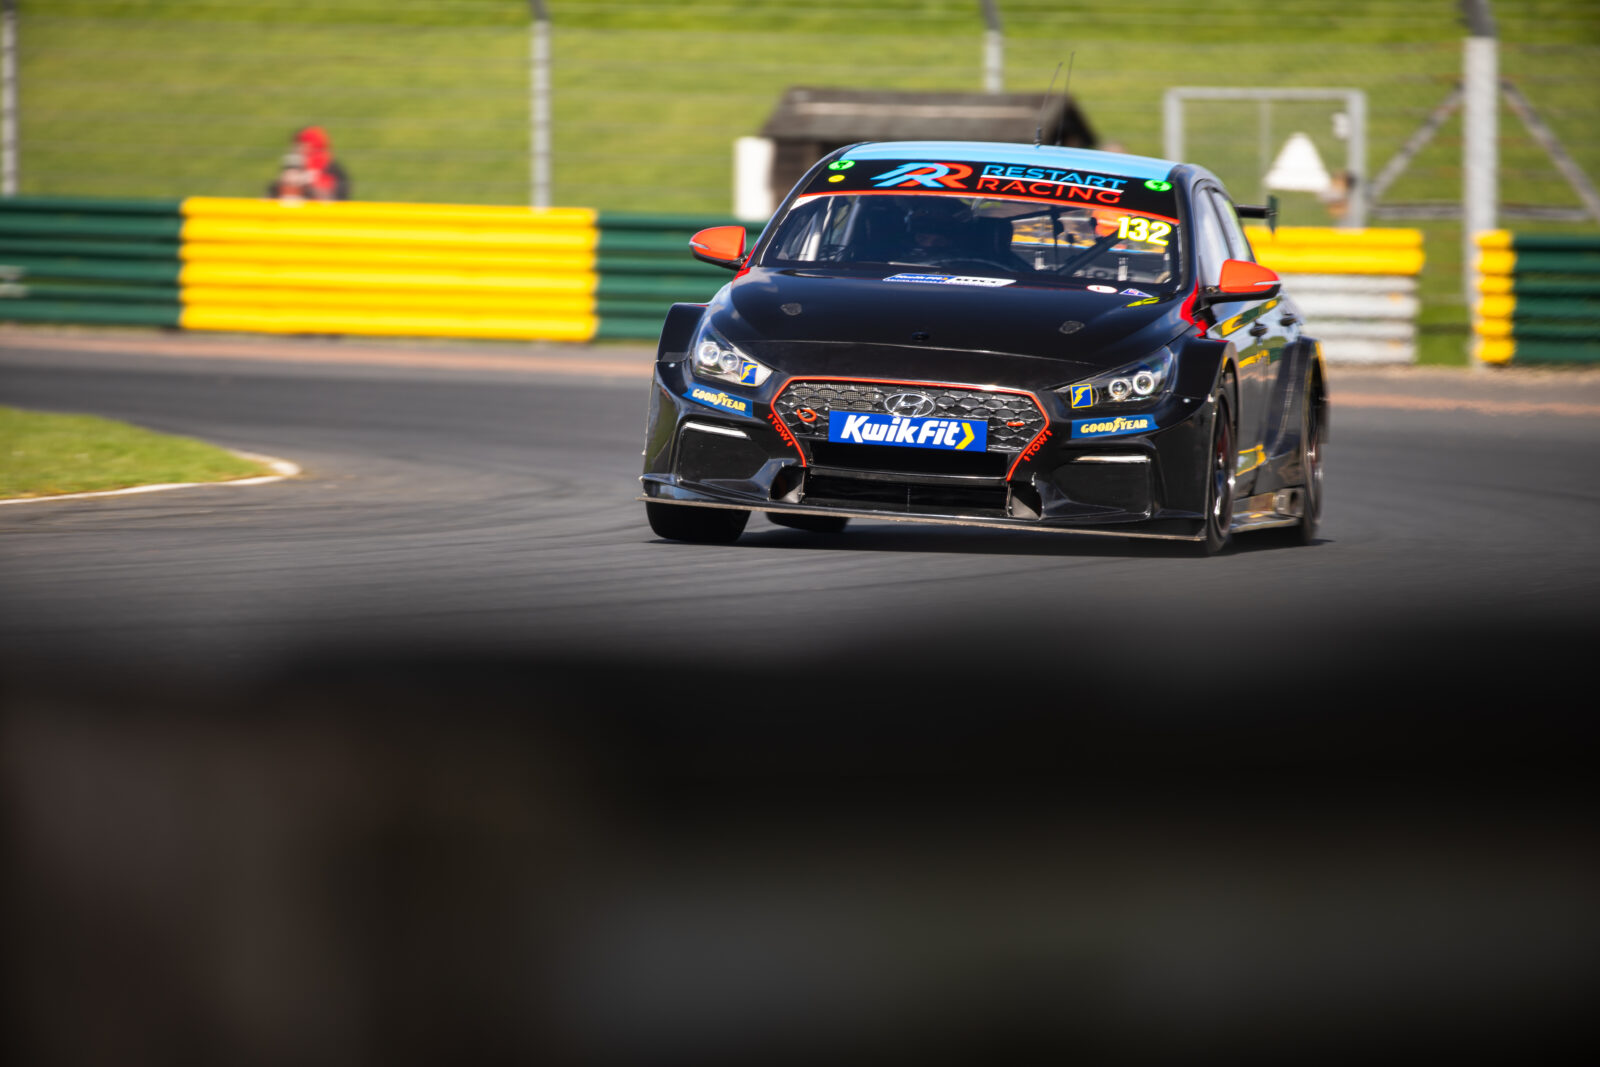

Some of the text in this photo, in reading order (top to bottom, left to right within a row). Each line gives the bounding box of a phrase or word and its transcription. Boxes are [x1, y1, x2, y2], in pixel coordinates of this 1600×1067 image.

[982, 164, 1128, 190] RESTART
[976, 177, 1121, 204] RACING
[1116, 215, 1172, 246] 132
[692, 388, 747, 412] GOODYEAR
[771, 419, 791, 442] TOW
[1080, 417, 1148, 434] GOODYEAR
[1027, 435, 1048, 458] TOW
